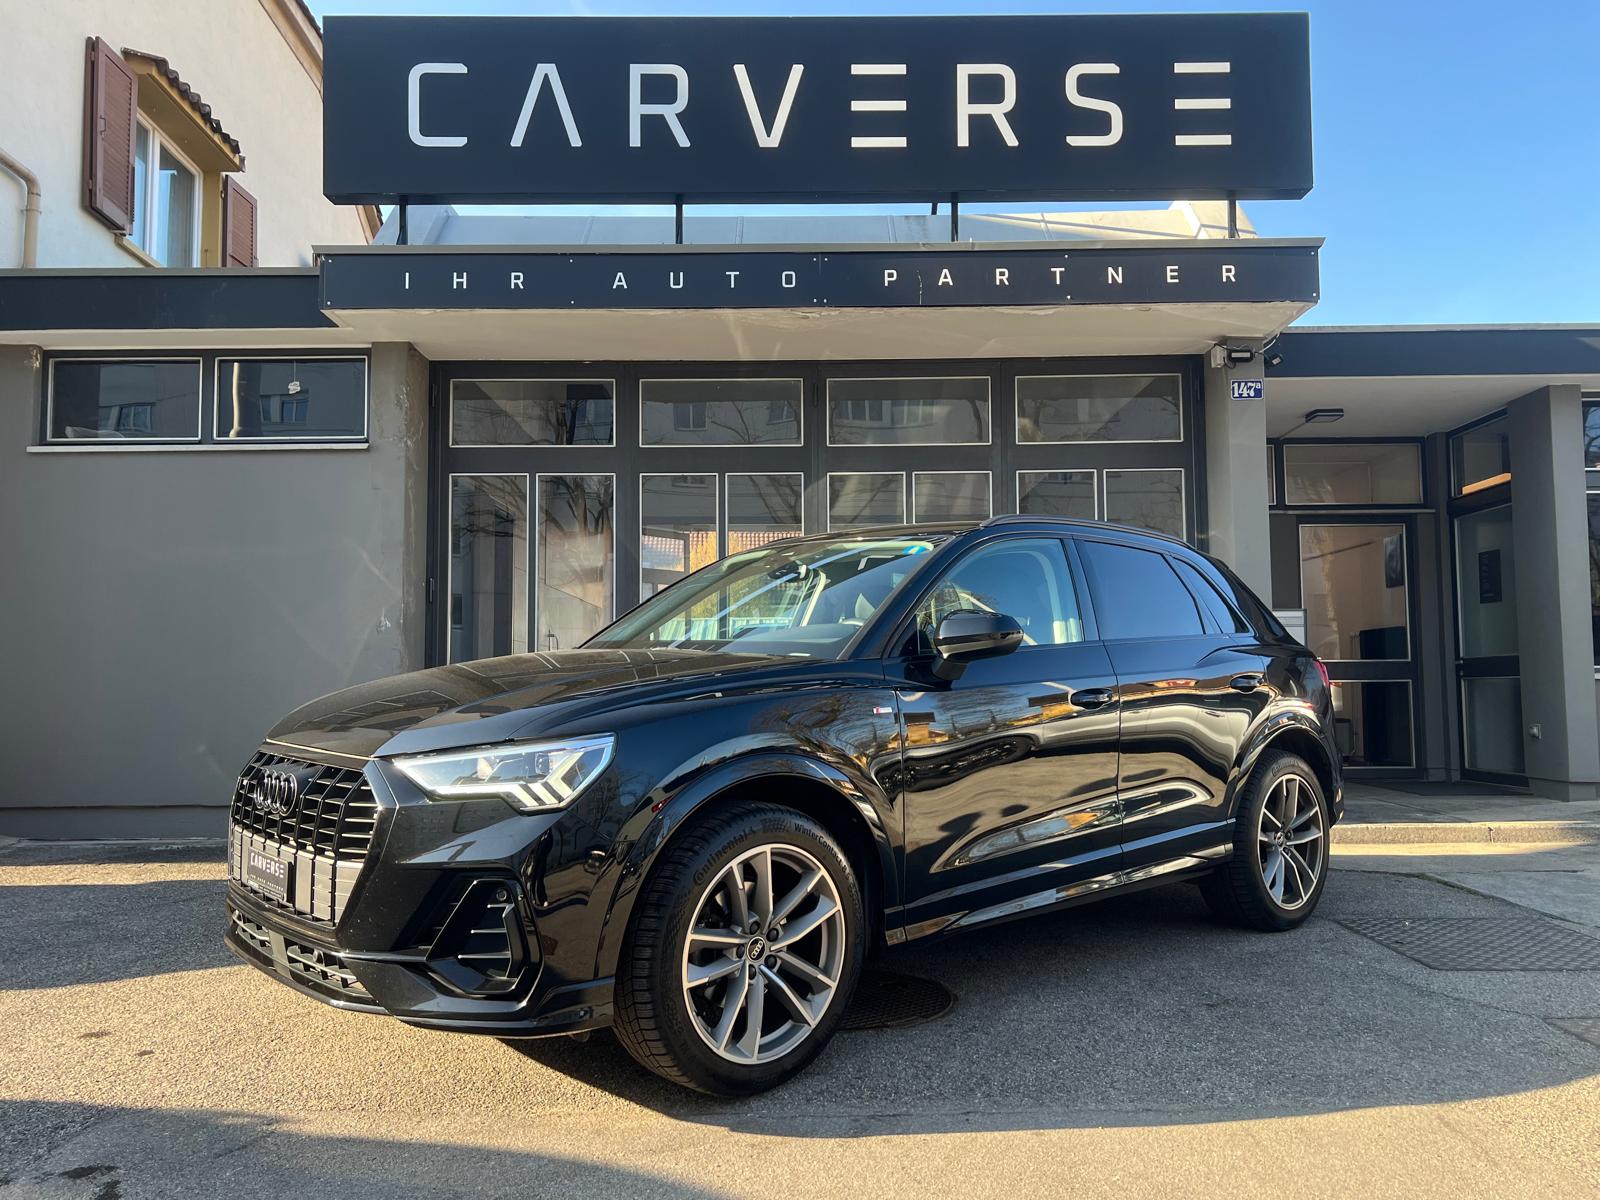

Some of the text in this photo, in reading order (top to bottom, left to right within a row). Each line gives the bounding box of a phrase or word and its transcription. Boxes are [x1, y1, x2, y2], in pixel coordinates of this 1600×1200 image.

[407, 61, 1232, 148] CARVERSE
[405, 264, 1236, 290] IHR AUTO PARTNER
[1232, 382, 1261, 397] 147a
[693, 827, 748, 886] Continental
[794, 822, 843, 866] WinterContact
[250, 852, 284, 878] CARVERSE
